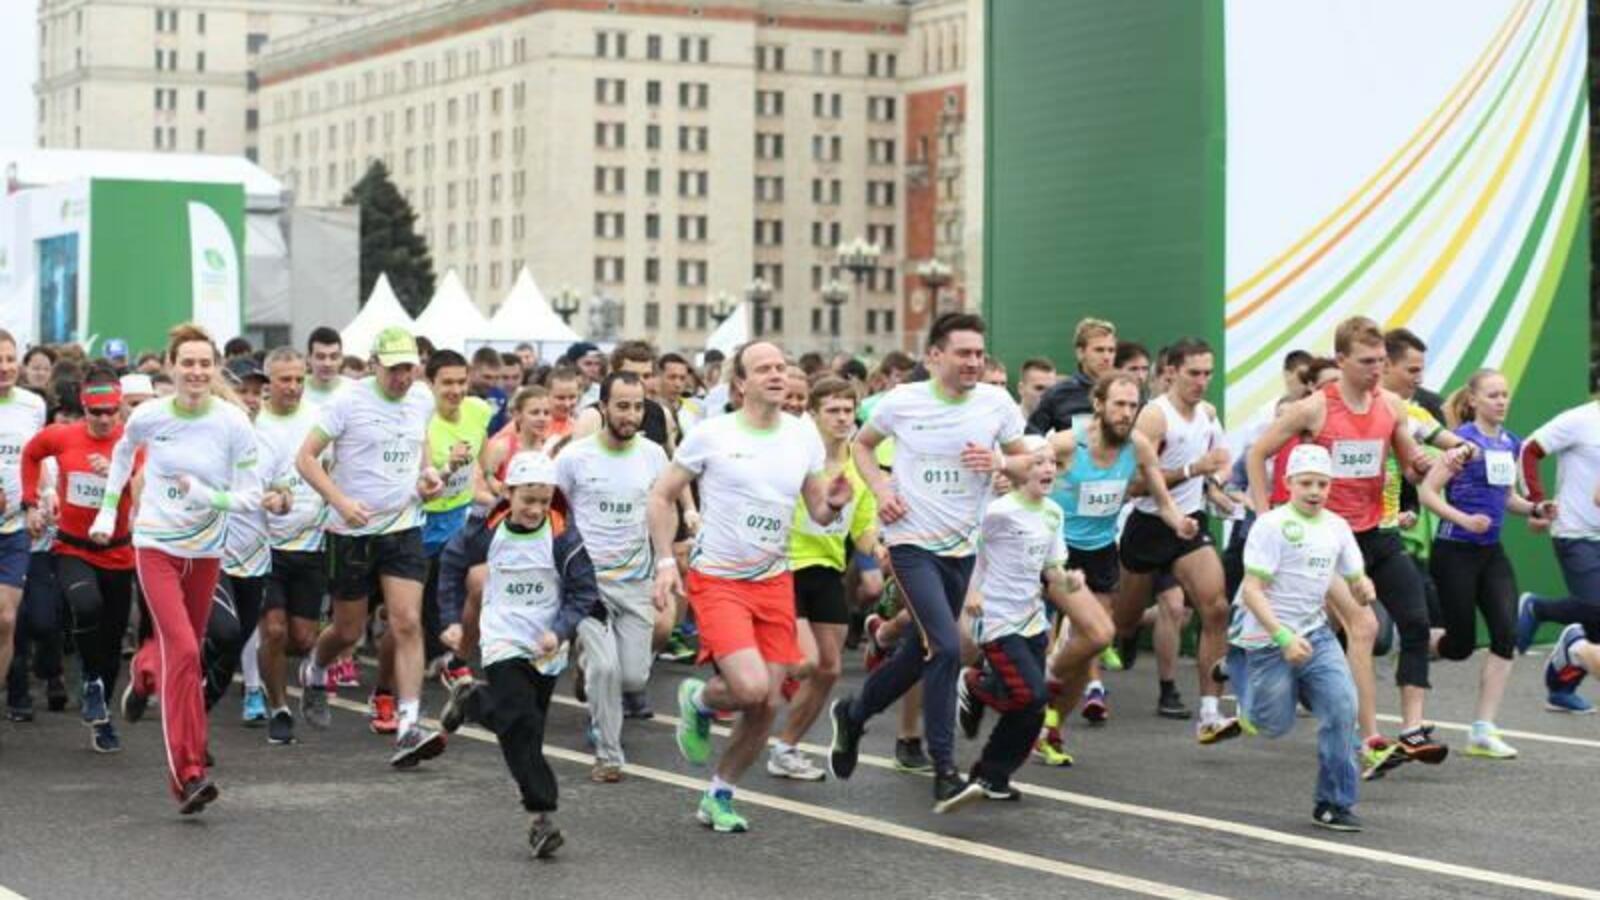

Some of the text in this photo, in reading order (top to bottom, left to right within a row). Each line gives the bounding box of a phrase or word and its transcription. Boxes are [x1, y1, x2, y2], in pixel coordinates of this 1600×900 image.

[924, 470, 959, 483] 0111
[747, 514, 781, 531] 0720
[506, 582, 544, 596] 4076
